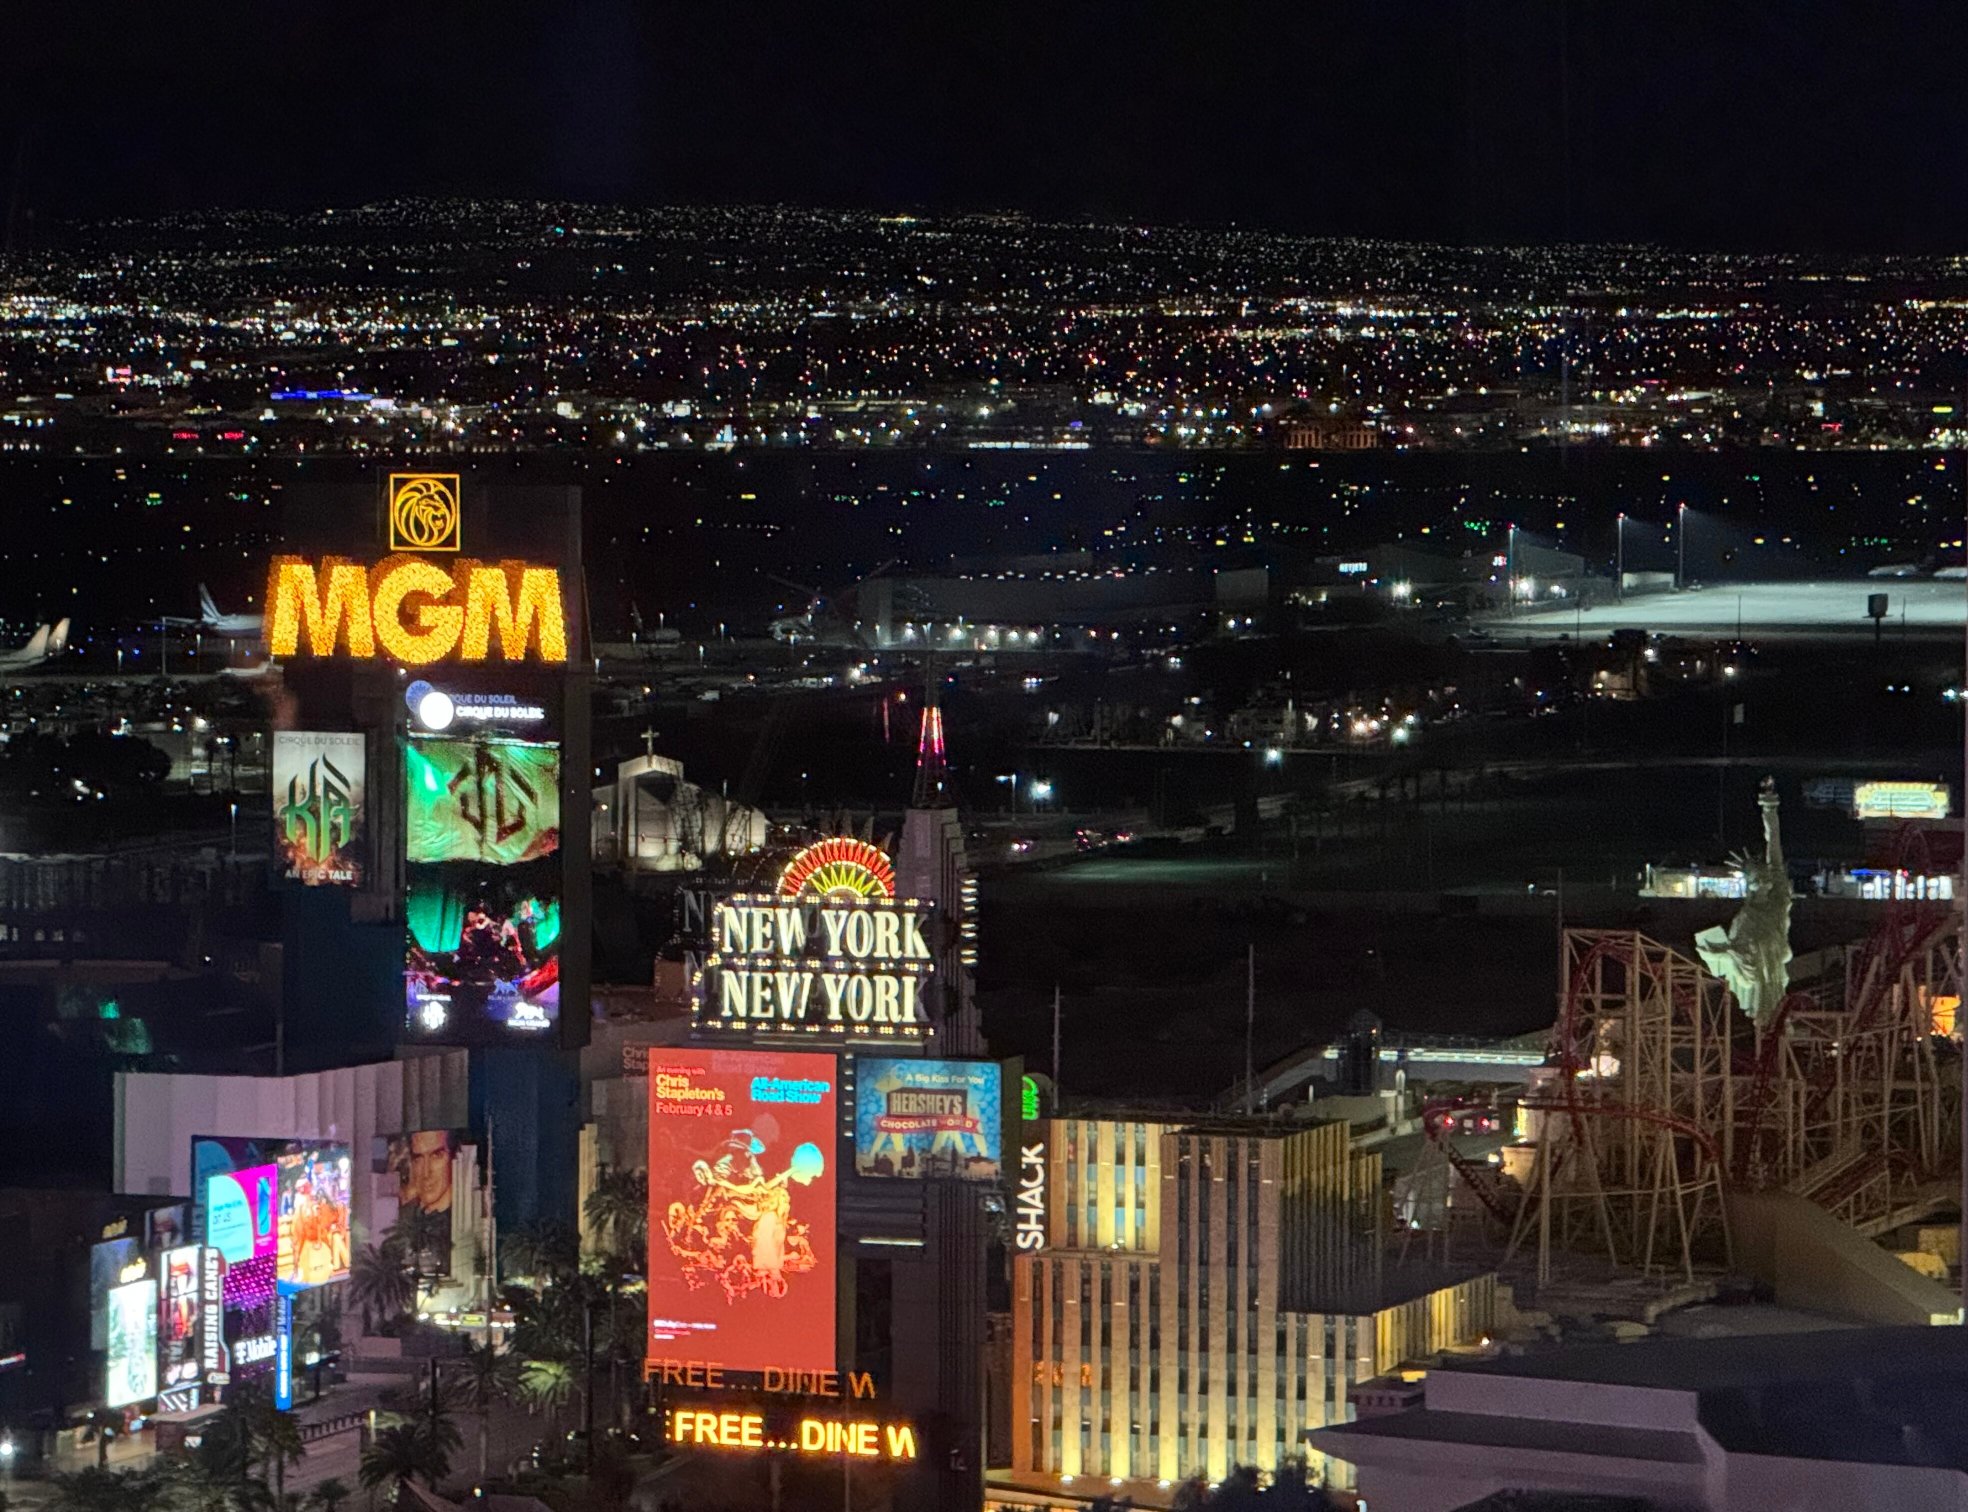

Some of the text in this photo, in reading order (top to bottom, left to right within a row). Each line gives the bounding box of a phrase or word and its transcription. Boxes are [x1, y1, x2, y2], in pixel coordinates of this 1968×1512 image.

[270, 561, 567, 664] MGM
[494, 706, 509, 718] DU
[328, 870, 353, 880] TALE
[721, 907, 807, 955] NEW
[822, 909, 931, 959] YORK
[720, 970, 814, 1019] NEW
[655, 1073, 690, 1088] Chris
[655, 1086, 726, 1102] Stapleton's
[890, 1092, 963, 1115] HERSHEY'S
[655, 1101, 704, 1117] February
[704, 1103, 713, 1115] 4
[714, 1103, 723, 1116] &
[1016, 1142, 1045, 1250] SHACK
